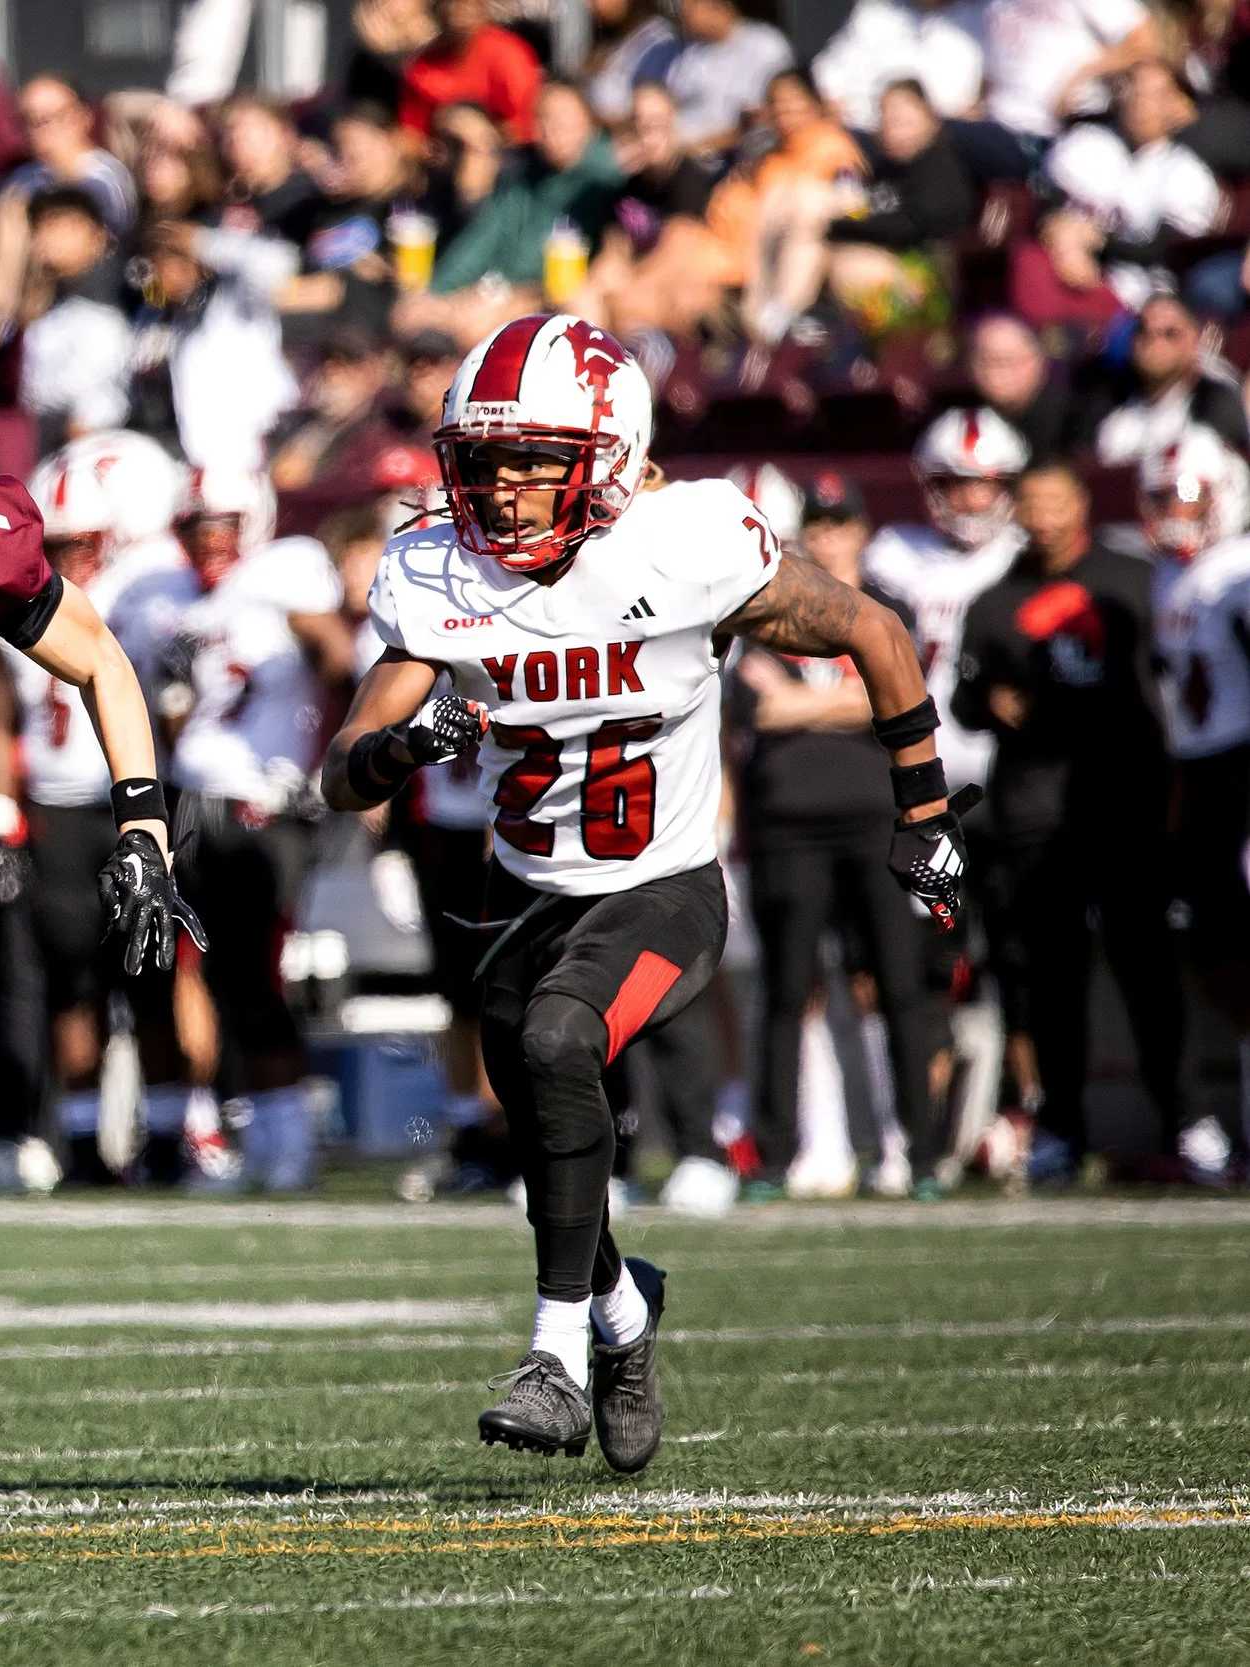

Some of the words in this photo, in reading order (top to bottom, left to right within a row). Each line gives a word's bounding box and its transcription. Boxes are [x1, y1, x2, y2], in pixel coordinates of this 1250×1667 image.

[442, 614, 494, 631] OUA
[481, 640, 646, 703] YORK
[491, 712, 664, 861] 26
